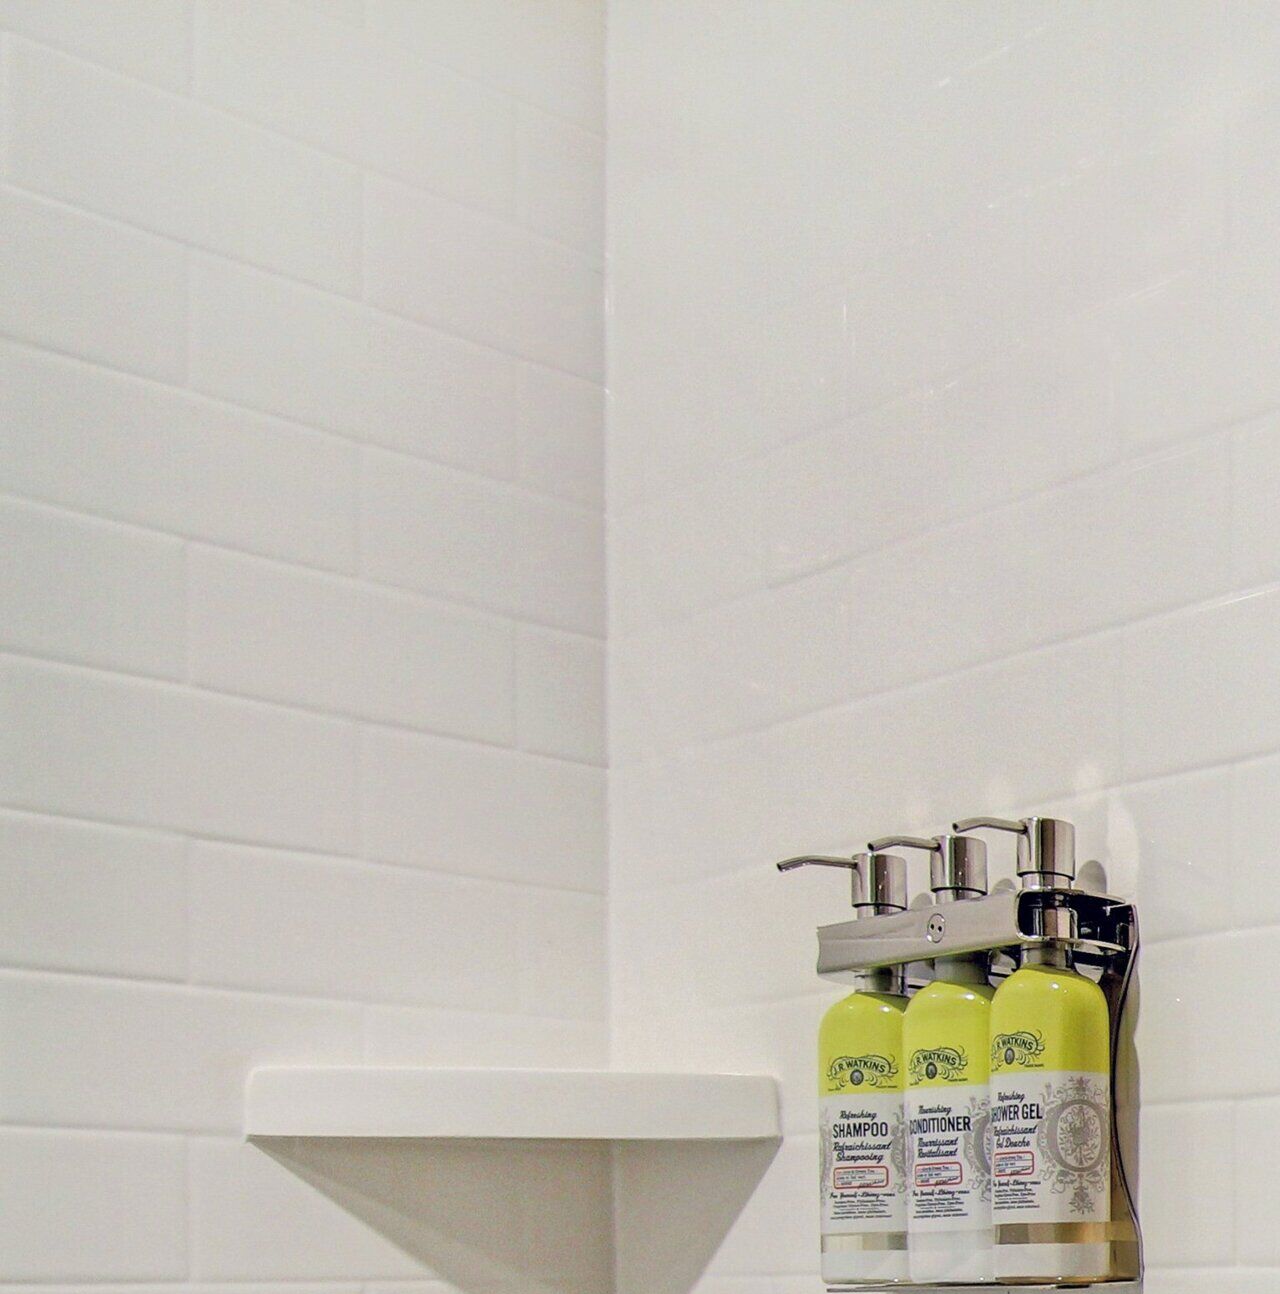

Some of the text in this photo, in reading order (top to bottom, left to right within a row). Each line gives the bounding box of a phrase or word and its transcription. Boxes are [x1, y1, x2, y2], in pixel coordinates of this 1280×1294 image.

[1001, 1036, 1034, 1051] WATKINS
[845, 1059, 886, 1073] WATKINS
[921, 1052, 957, 1066] WATKINS
[839, 1109, 877, 1121] Refreshing
[1021, 1103, 1043, 1120] GEL
[832, 1122, 888, 1139] SHAMPOO
[910, 1116, 971, 1135] CONDITIONER
[836, 1151, 884, 1164] Shampooing
